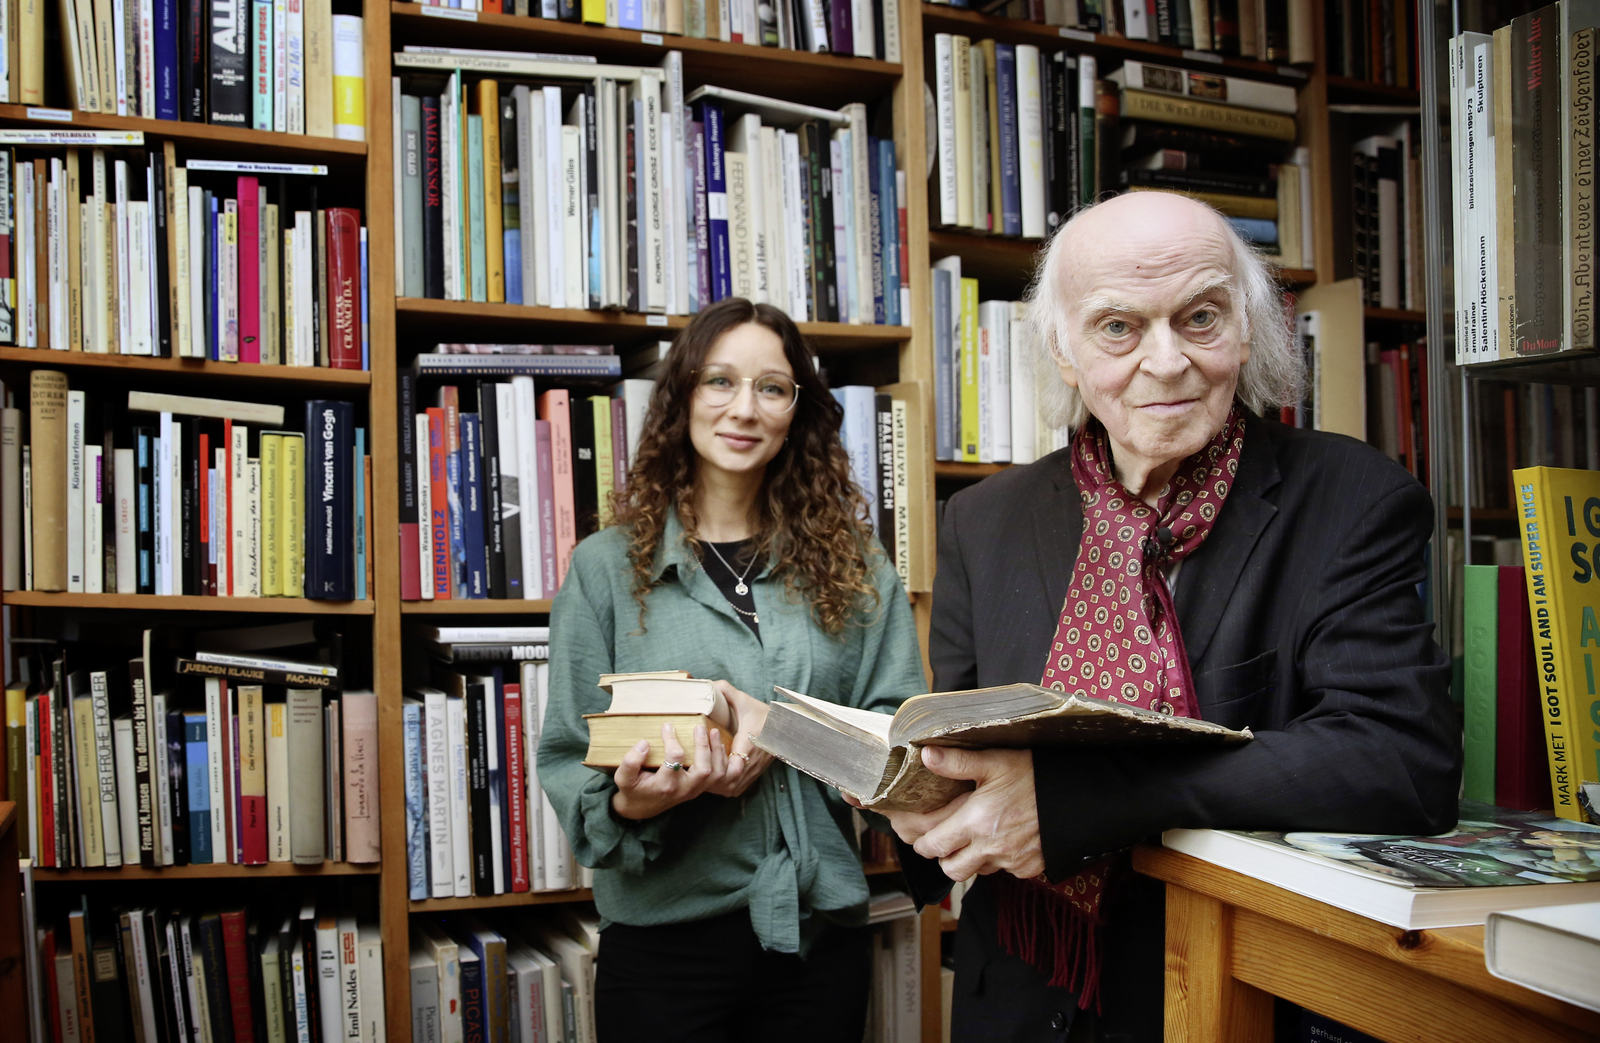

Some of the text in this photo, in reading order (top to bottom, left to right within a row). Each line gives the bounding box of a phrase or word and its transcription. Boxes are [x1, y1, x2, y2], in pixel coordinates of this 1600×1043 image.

[259, 5, 268, 94] DER BUNTE SPIEGEL
[1526, 17, 1543, 91] Walter Aue
[648, 96, 656, 126] HOMO
[406, 132, 417, 176] OTTO DIX
[422, 103, 439, 208] JAMES ENSOR
[650, 156, 659, 188] GROSZ
[1467, 130, 1475, 210] blindzeichnungen
[1573, 141, 1591, 187] einer
[652, 191, 660, 230] GEORGE
[1475, 55, 1489, 353] Salentin/Höckelmann Skulpturen
[697, 226, 708, 249] Erich
[1573, 195, 1591, 288] Abenteuer
[757, 265, 767, 291] Karl
[335, 296, 345, 329] LUCAS
[344, 299, 354, 349] CRANACH
[1508, 303, 1516, 352] interfunktionen
[1522, 338, 1558, 352] DuMont
[323, 409, 336, 440] Gogh
[325, 441, 334, 460] van
[882, 411, 894, 510] MALEWITSCH
[323, 460, 334, 502] Vincent
[1520, 484, 1535, 519] NICE
[325, 505, 333, 528] Arnold
[420, 484, 430, 552] Wassily Kandinsky
[433, 509, 448, 593] KIENHOLZ
[545, 534, 553, 554] Bilder
[1527, 522, 1543, 572] SUPER
[1533, 575, 1546, 597] AM
[1537, 608, 1551, 640] AND
[228, 667, 265, 679] KLAUKE
[1541, 642, 1557, 683] SOUL
[1546, 686, 1560, 718] GOT
[92, 675, 115, 803] DER FRÜHE HODLER
[1552, 733, 1566, 762] MET
[132, 678, 153, 851] Franz M. Jansen Von damals bis heute
[430, 716, 448, 845] AGNES MARTIN
[1557, 765, 1571, 806] MARK
[512, 824, 522, 846] Meese
[296, 991, 307, 1031] Mueller
[346, 969, 360, 1038] Emil Noldes
